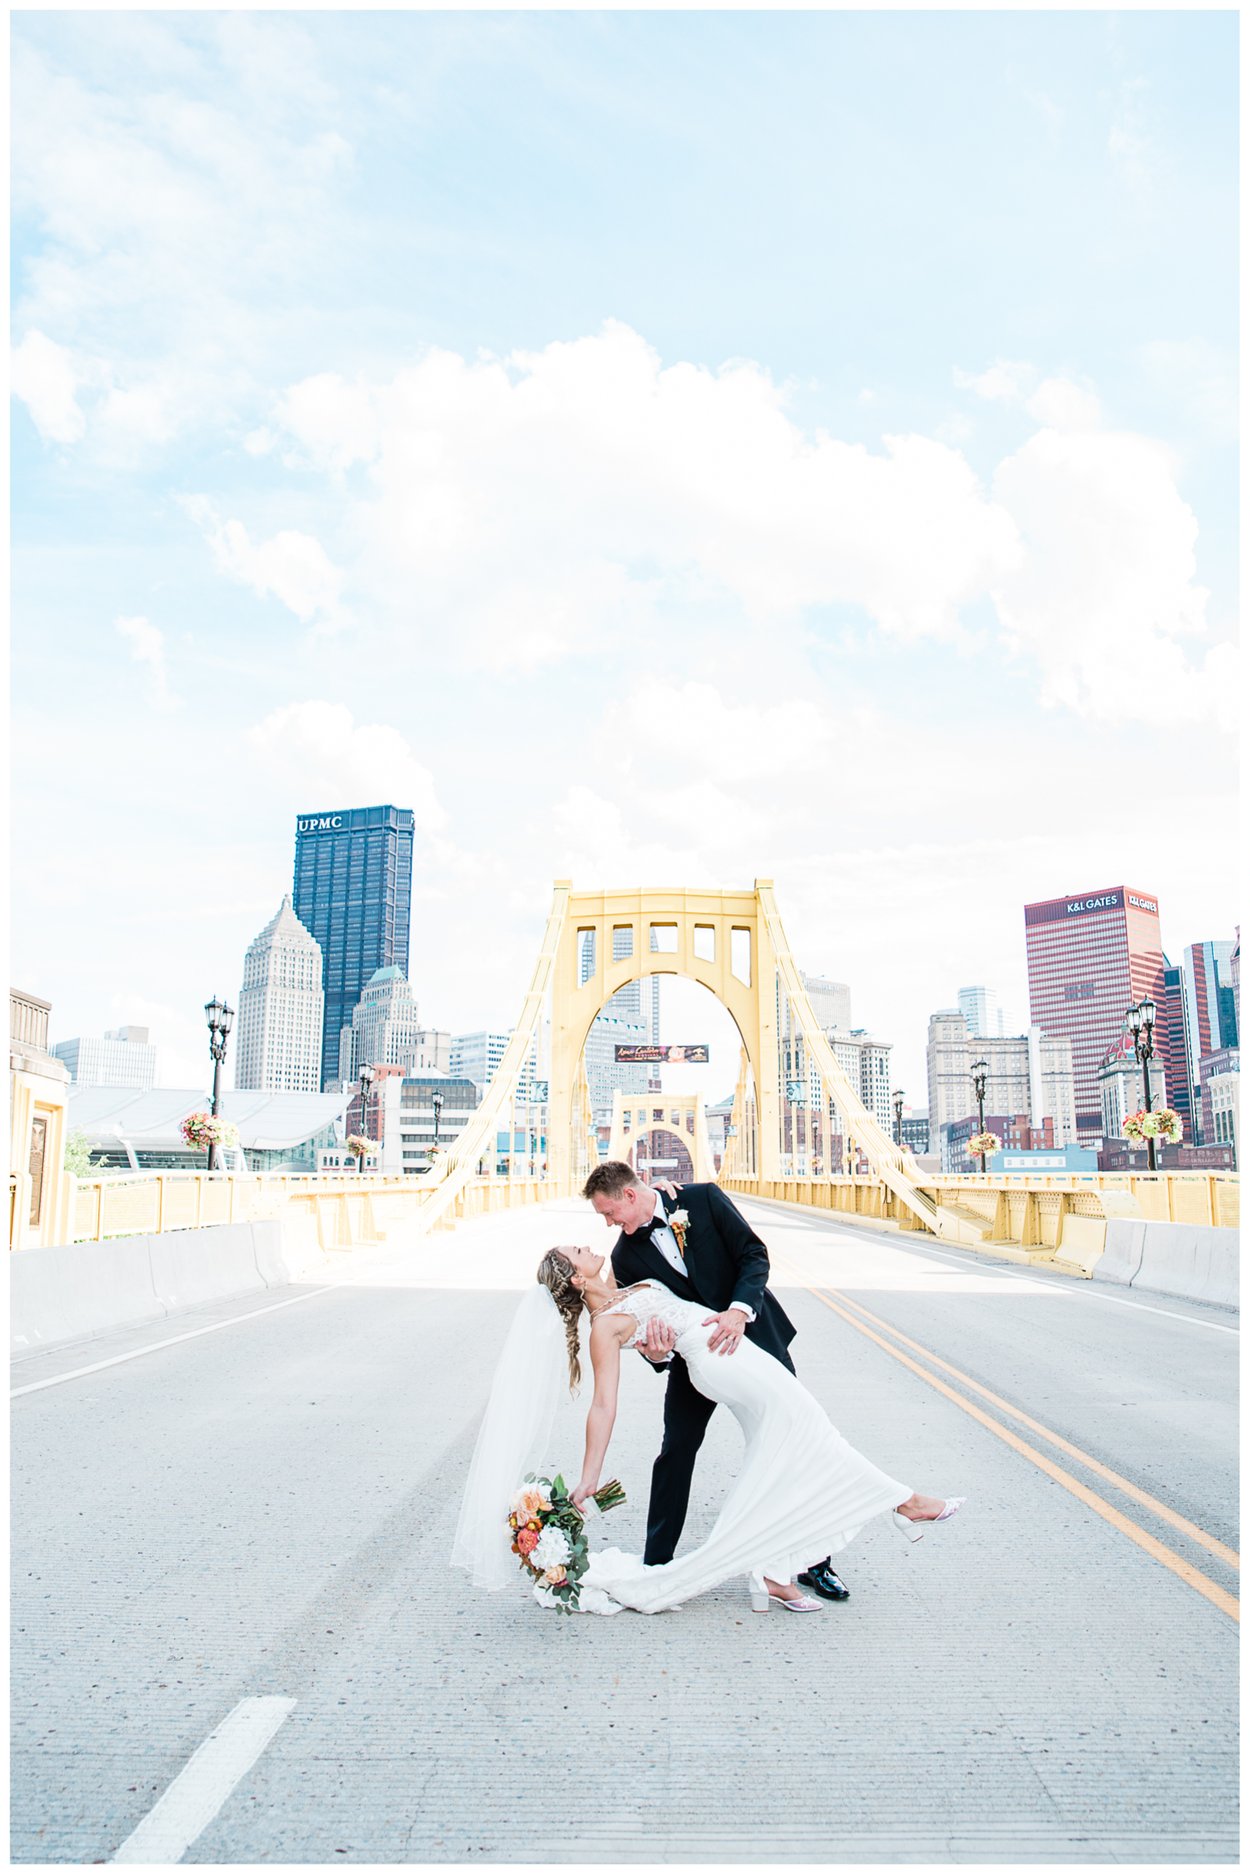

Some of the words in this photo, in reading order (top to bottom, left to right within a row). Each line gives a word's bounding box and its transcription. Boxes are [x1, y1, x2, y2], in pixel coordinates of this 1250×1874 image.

[298, 815, 342, 832] UPMC
[1067, 902, 1085, 913] K&L
[1086, 895, 1118, 909] GATES
